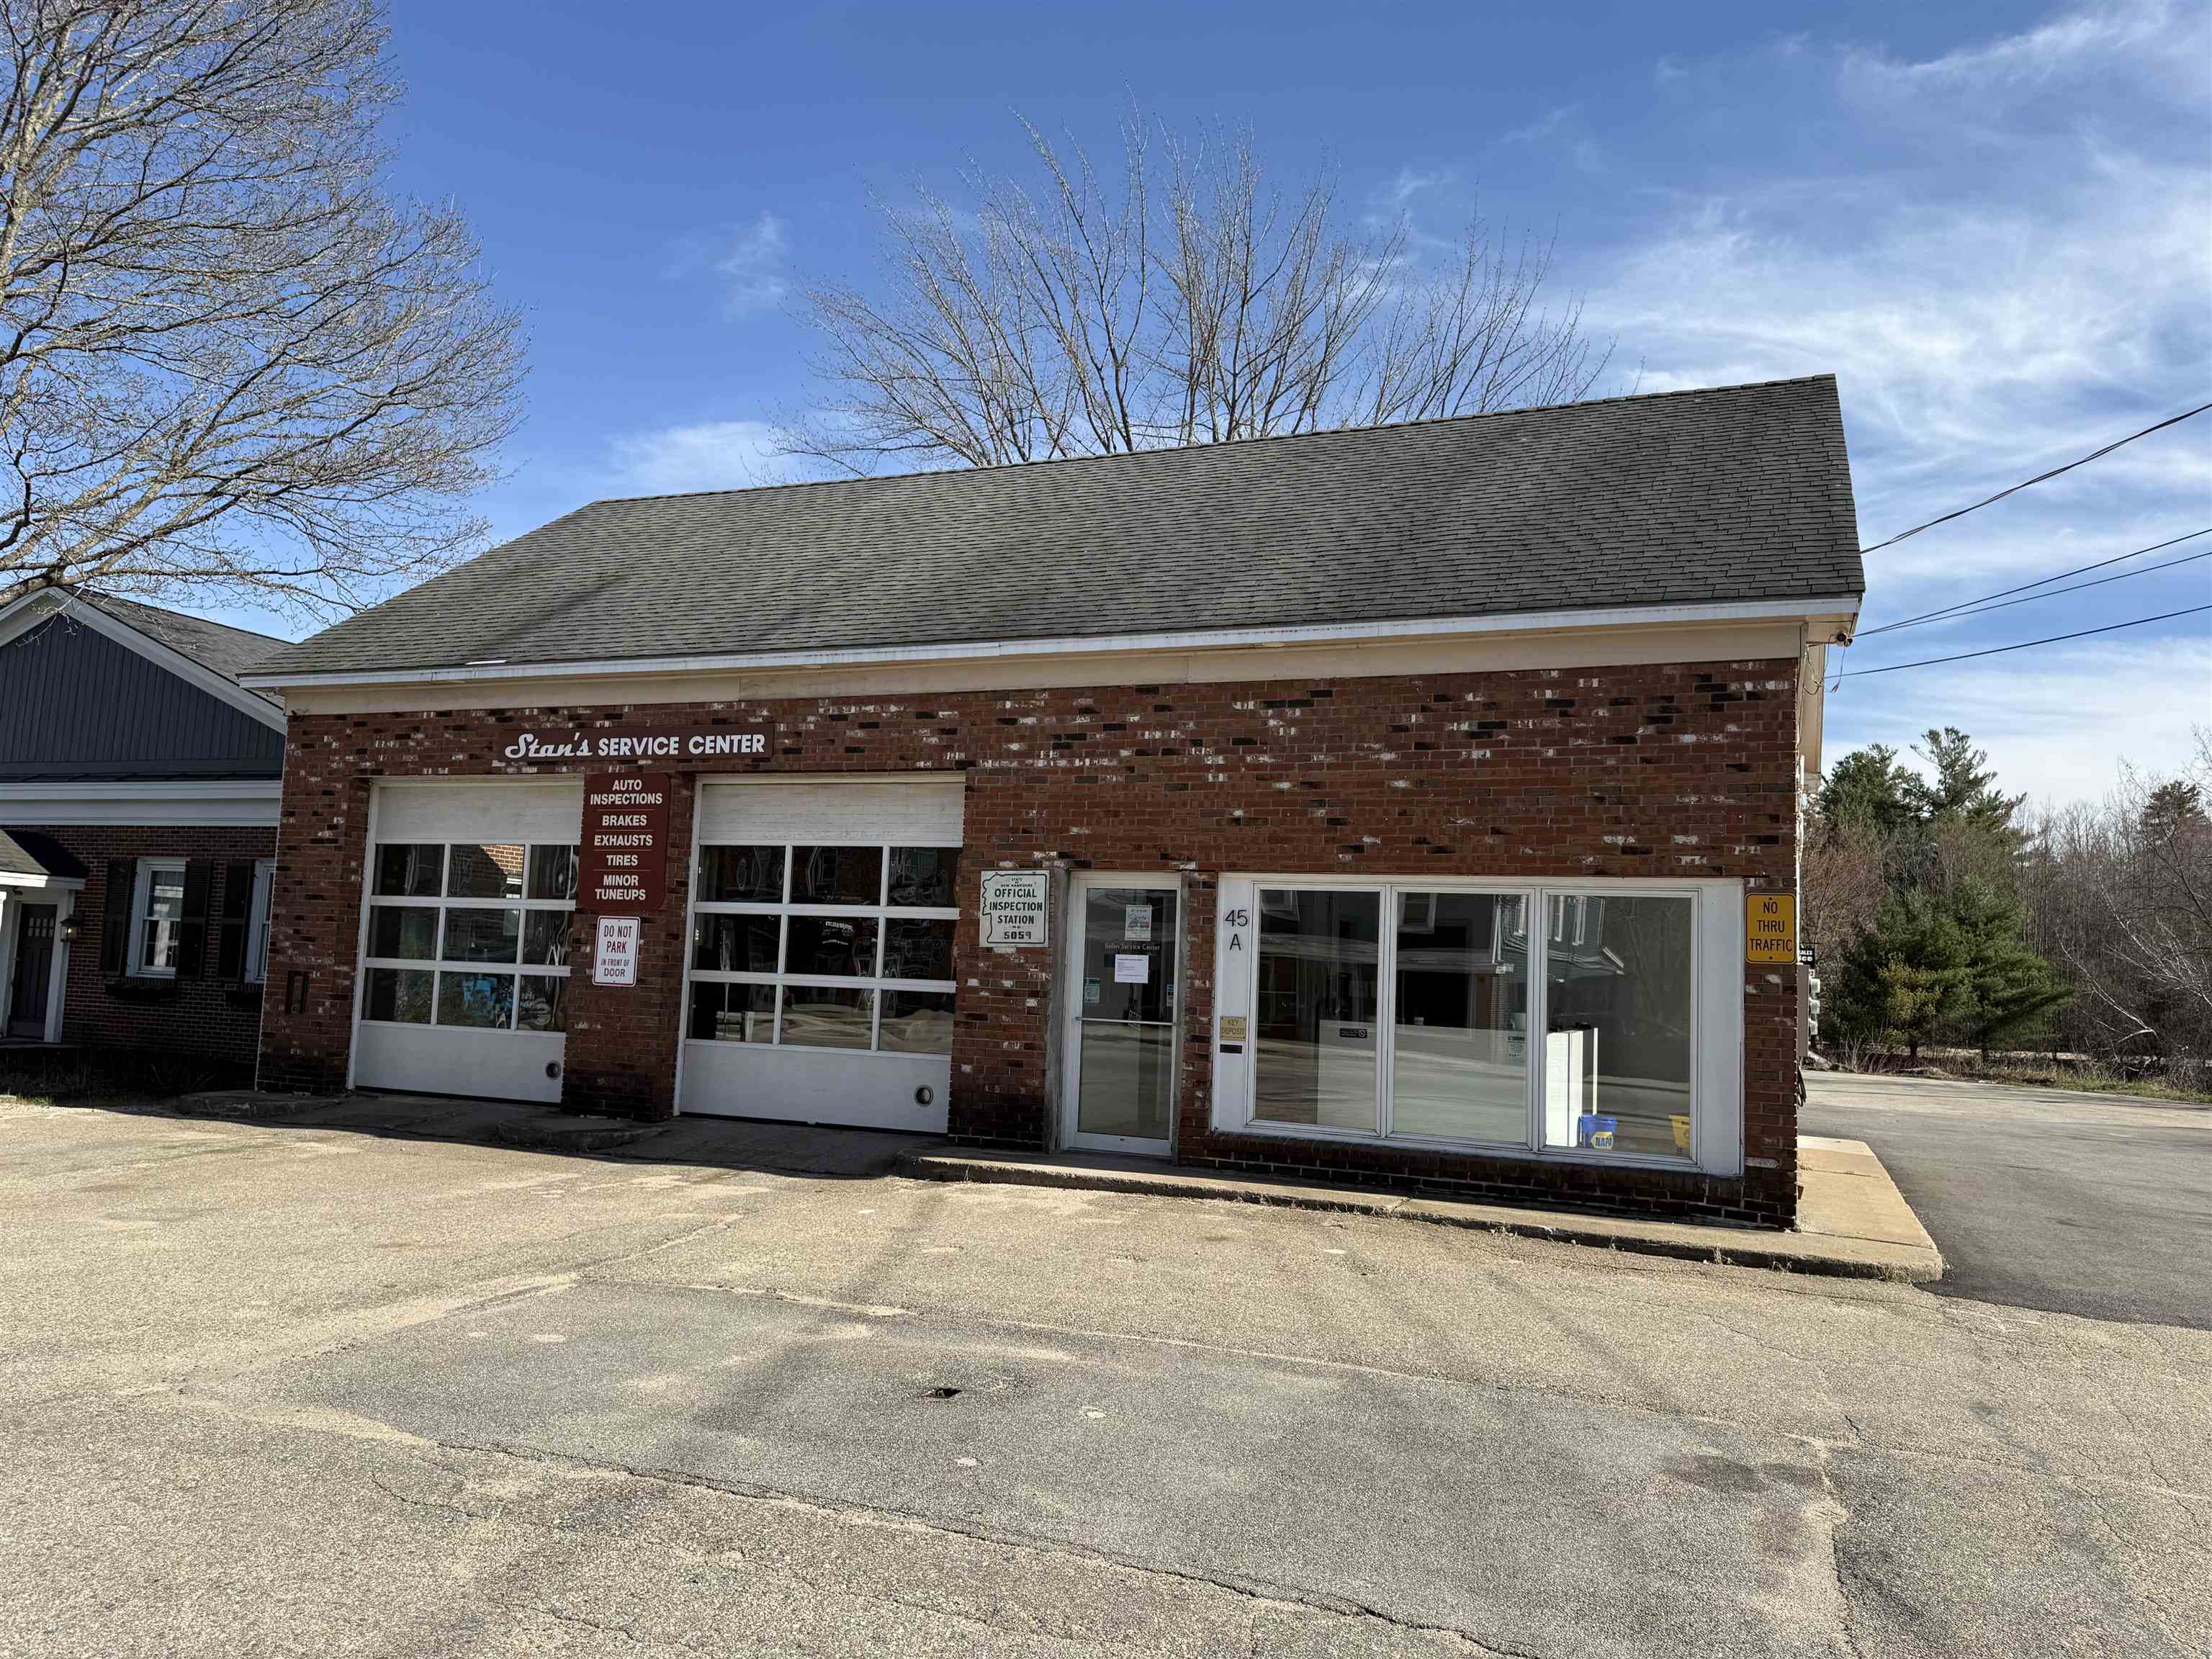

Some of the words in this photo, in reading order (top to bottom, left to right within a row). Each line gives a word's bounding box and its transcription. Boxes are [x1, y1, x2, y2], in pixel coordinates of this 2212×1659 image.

[505, 732, 592, 758] Stan's
[598, 737, 680, 756] SERVICE
[688, 734, 765, 755] CENTER
[612, 779, 642, 791] AUTO
[590, 793, 662, 805] INSPECTIONS
[602, 814, 647, 826] BRAKES
[594, 835, 653, 846] EXHAUSTS
[606, 855, 638, 866] TIRES
[603, 875, 639, 886] MINOR
[595, 889, 646, 901] TUNEUPS
[994, 889, 1037, 898] OFFICIAL
[989, 902, 1043, 912] INSPECTION
[1763, 902, 1778, 914] NO
[997, 914, 1034, 925] STATION
[1224, 909, 1248, 927] 45
[604, 925, 614, 938] DO
[618, 925, 632, 938] NOT
[1757, 920, 1785, 932] THRU
[1003, 931, 1032, 940] 5059
[606, 941, 627, 953] PARK
[1229, 933, 1241, 951] A
[1750, 938, 1792, 952] TRAFFIC
[604, 968, 626, 977] DOOR
